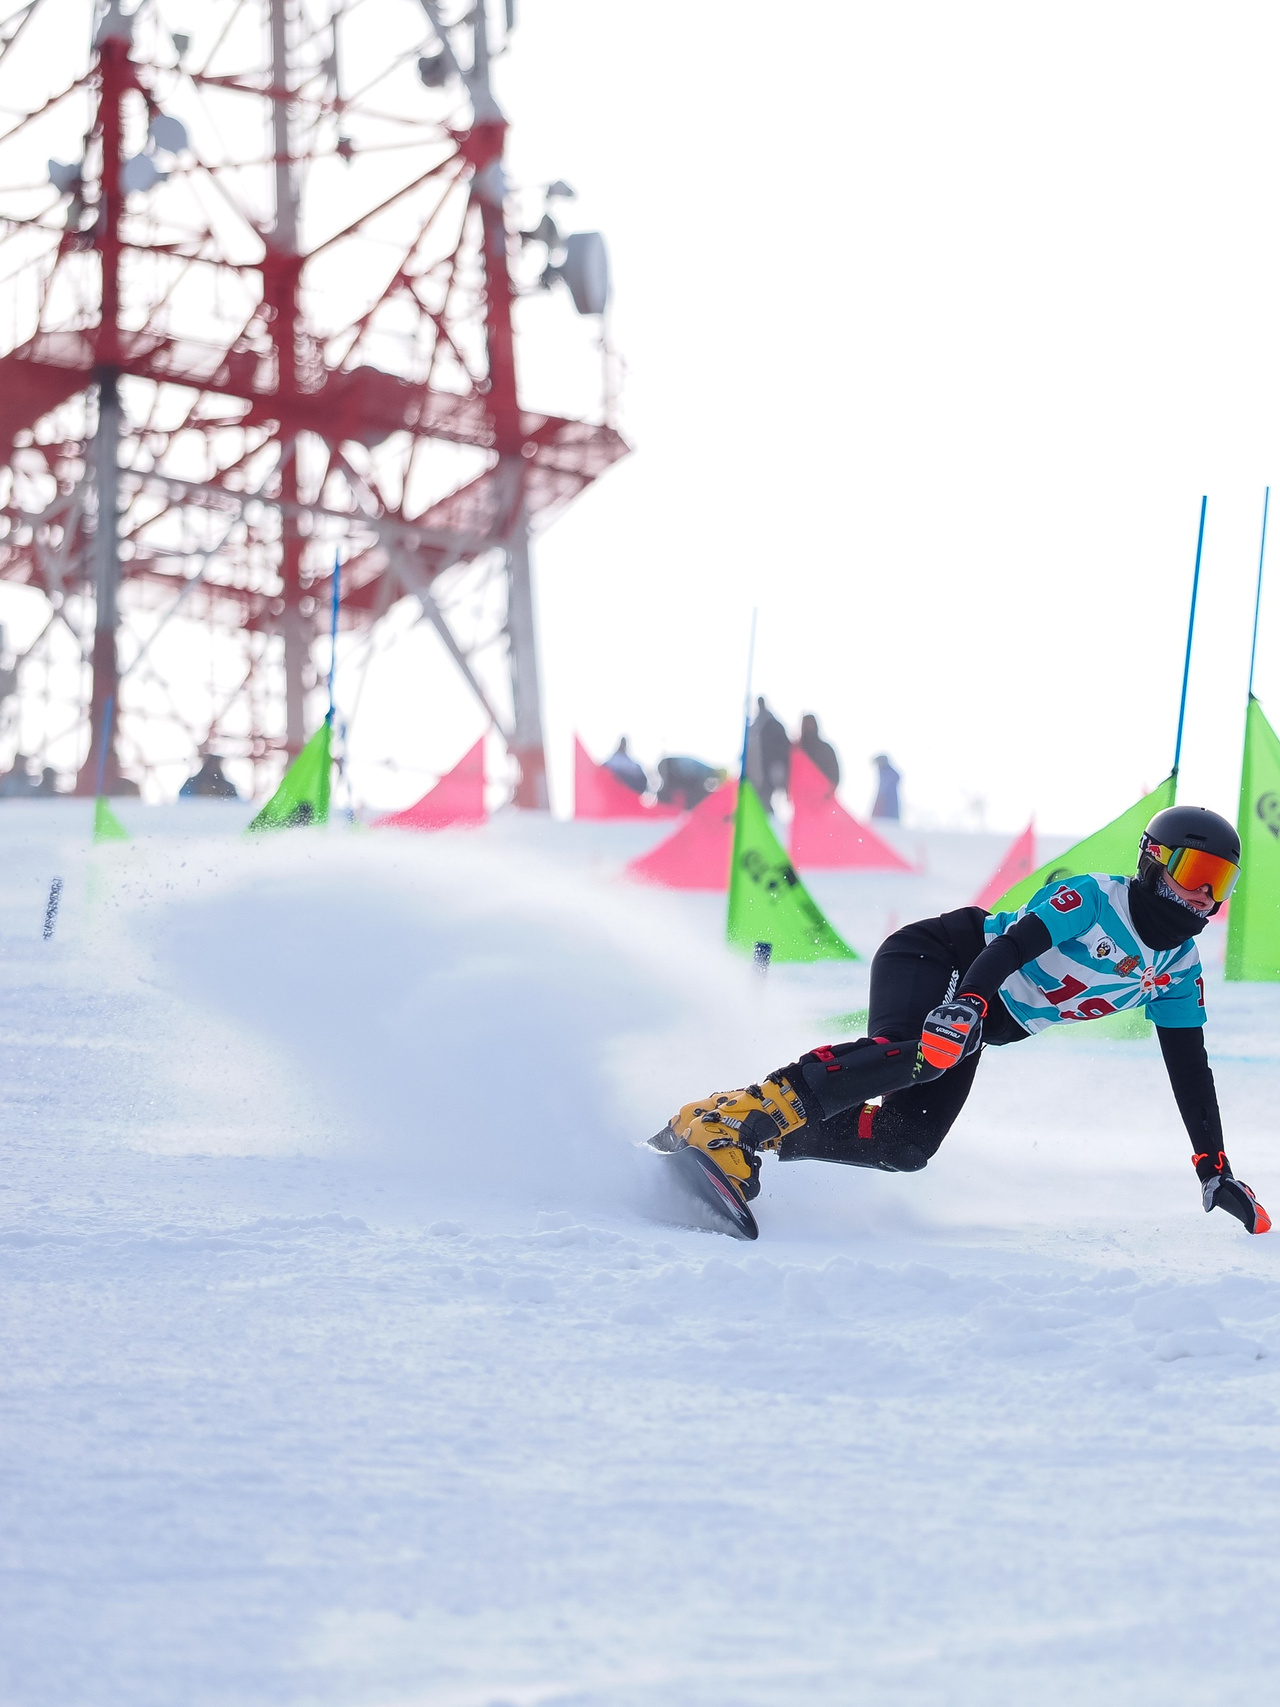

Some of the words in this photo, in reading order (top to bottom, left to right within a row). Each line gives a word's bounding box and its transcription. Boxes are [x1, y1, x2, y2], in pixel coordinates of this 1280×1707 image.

[1183, 839, 1206, 849] SMITH
[1040, 974, 1118, 1020] 19
[935, 1026, 960, 1039] reusch
